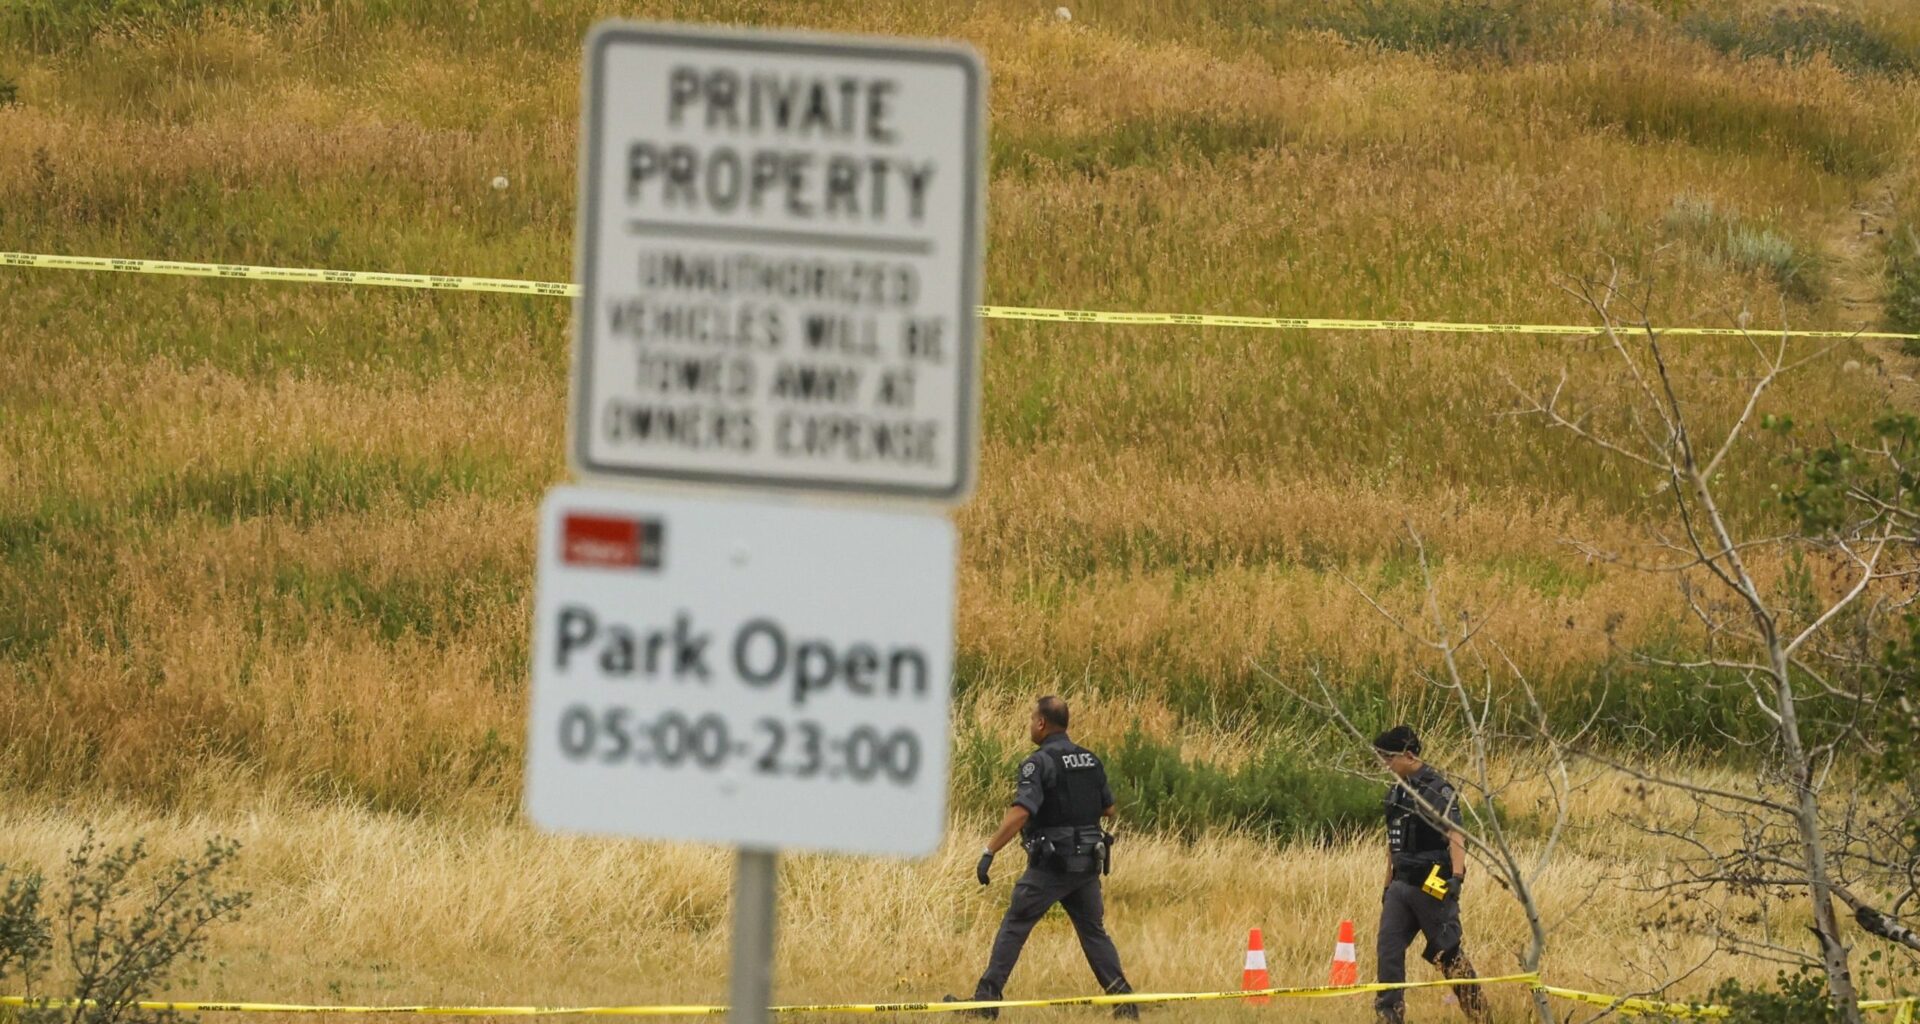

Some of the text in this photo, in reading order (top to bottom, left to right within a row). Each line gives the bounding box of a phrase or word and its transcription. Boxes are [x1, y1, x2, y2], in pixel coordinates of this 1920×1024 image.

[666, 62, 901, 144] PRIVATE
[625, 139, 937, 226] PROPERTY
[637, 251, 922, 307] UNAUTHORIZED
[606, 299, 946, 365] VEHICLES WILL BE
[636, 346, 917, 407] TOWED AWAY AT
[603, 397, 940, 467] OWNERS EXPENSE
[553, 604, 931, 707] Park Open
[557, 704, 922, 788] 05:00-23:00
[1062, 753, 1095, 768] POLICE
